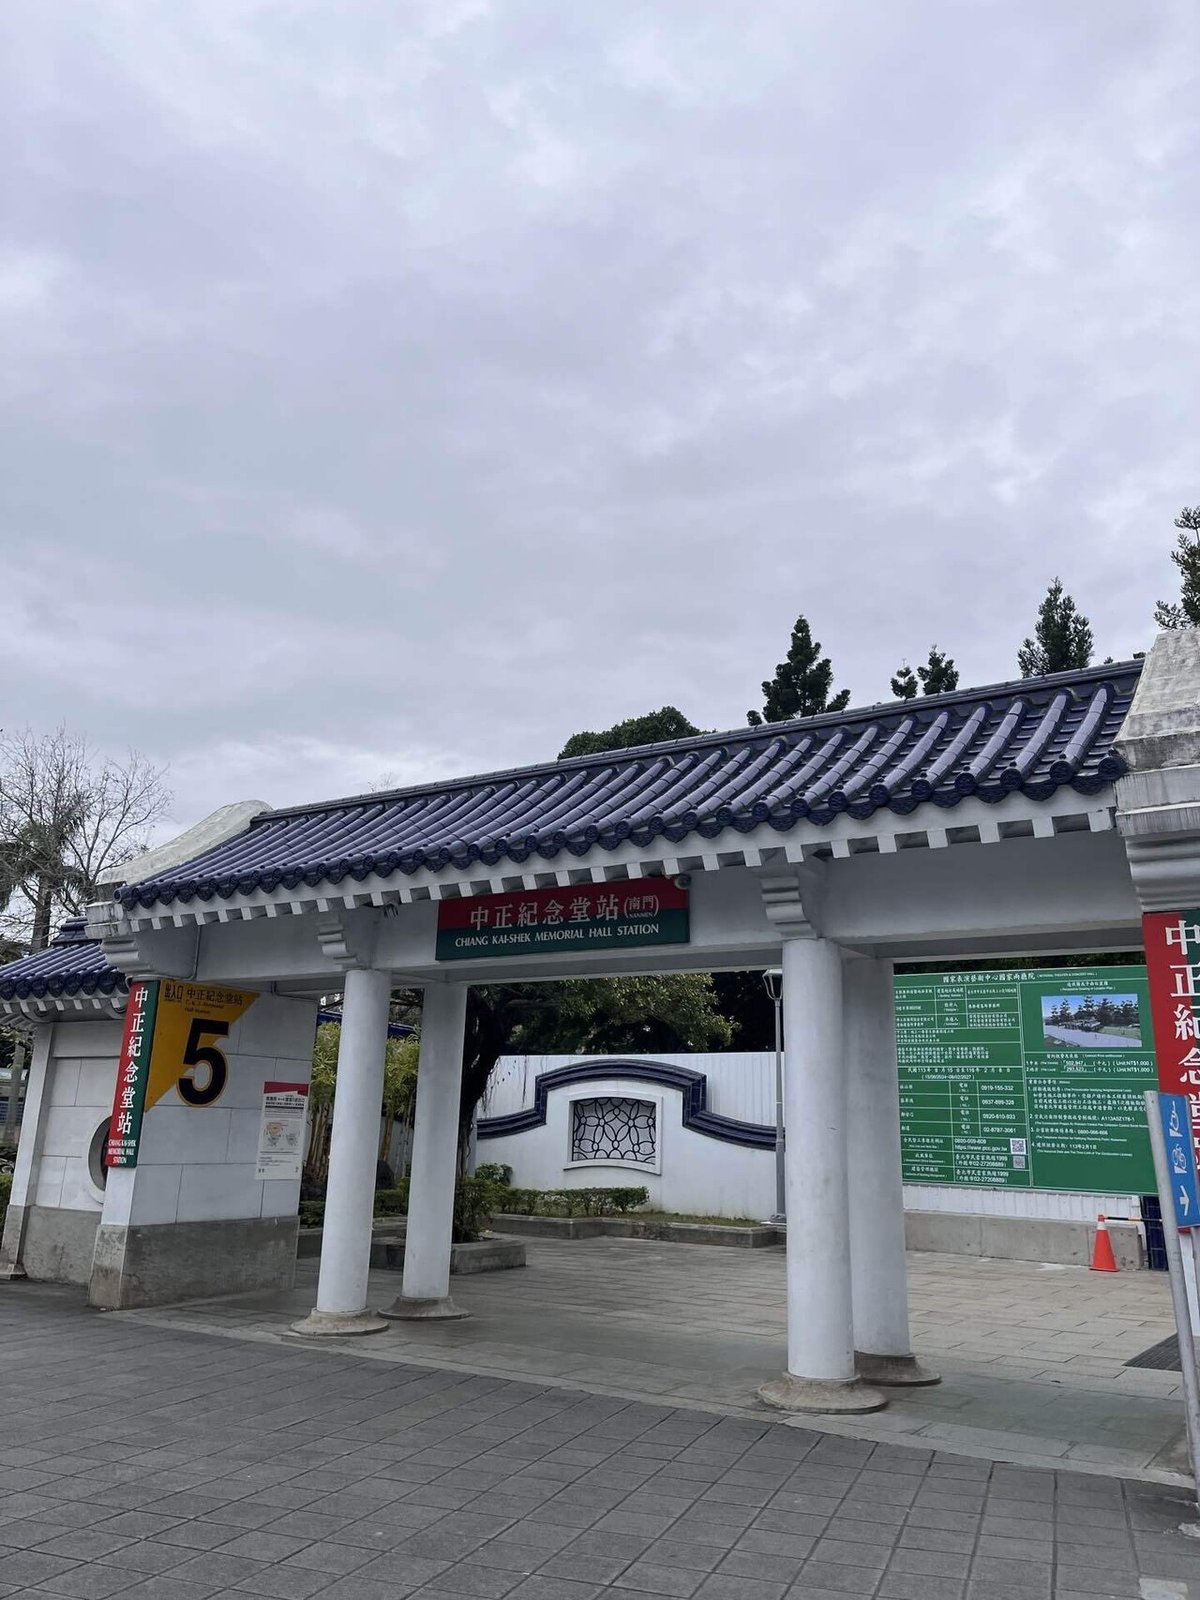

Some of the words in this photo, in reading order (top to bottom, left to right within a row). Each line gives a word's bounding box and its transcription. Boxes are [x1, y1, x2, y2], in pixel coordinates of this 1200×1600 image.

[455, 935, 488, 947] CHIANG
[492, 932, 531, 944] KAI-SHEK
[534, 928, 584, 942] MEMORIAL
[588, 926, 612, 938] HALL
[617, 923, 659, 936] STATION
[470, 894, 619, 931] 中正紀念堂站
[116, 987, 149, 1134] 中正紀念堂站
[178, 1018, 229, 1106] 5
